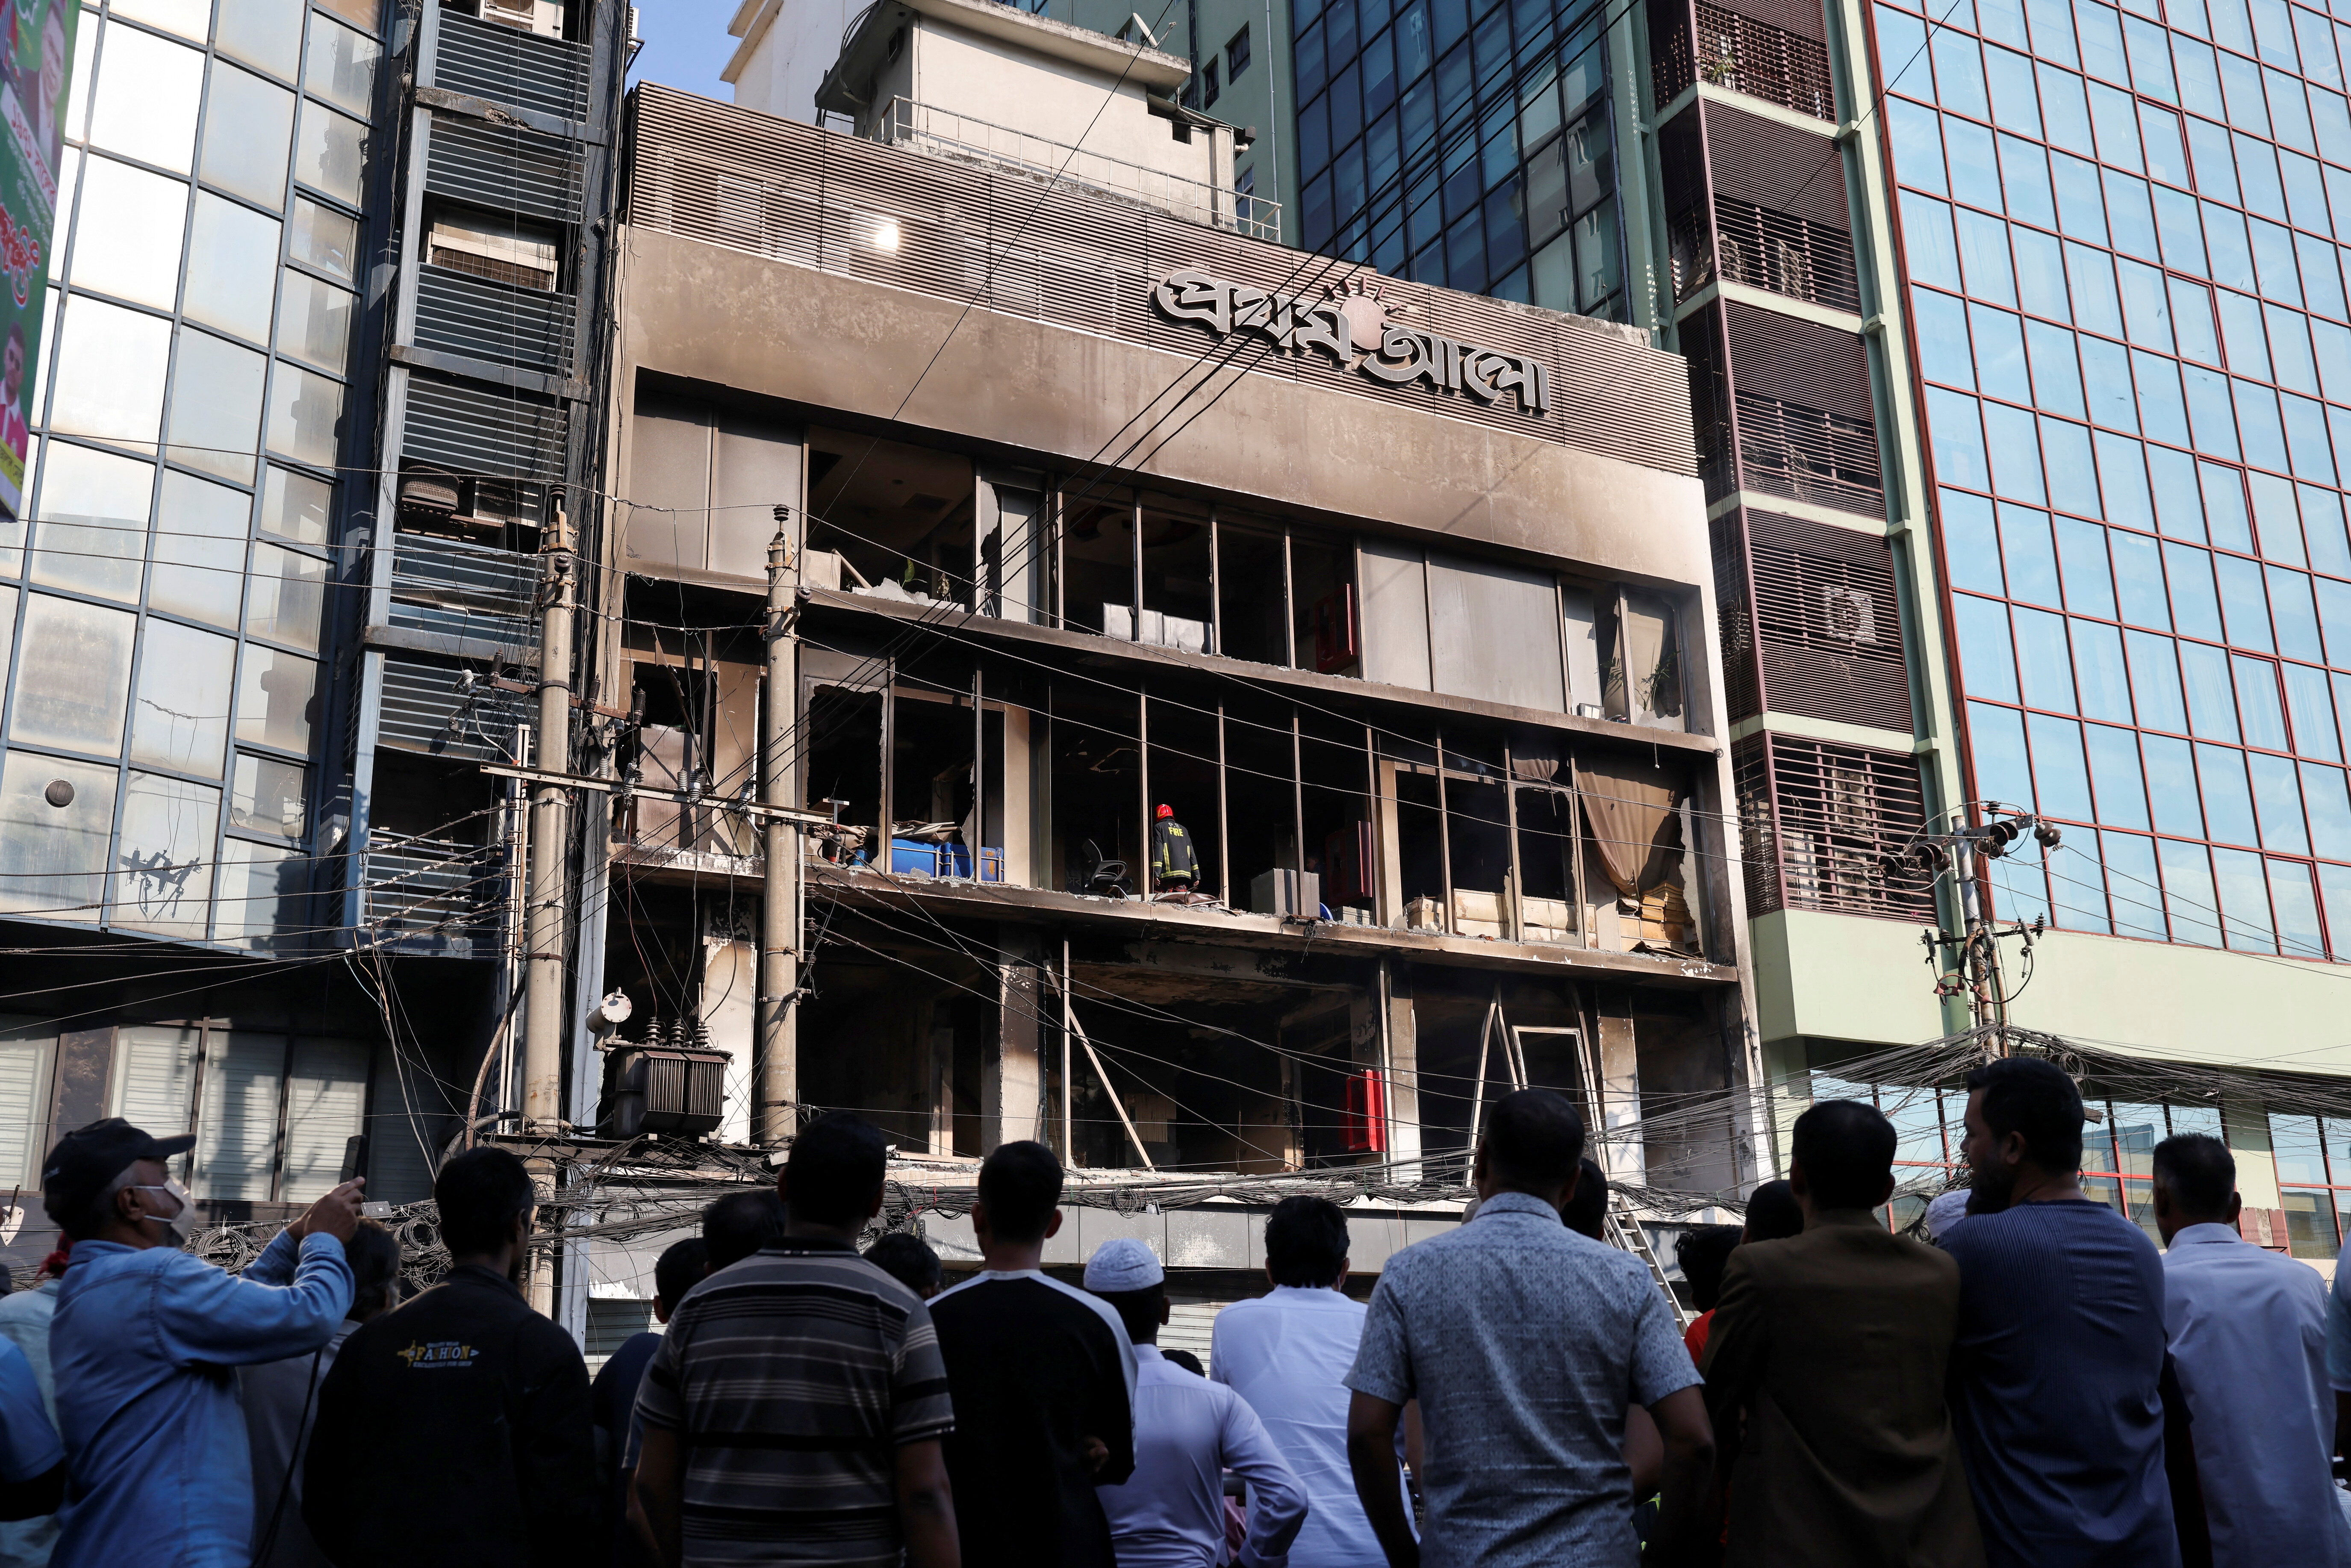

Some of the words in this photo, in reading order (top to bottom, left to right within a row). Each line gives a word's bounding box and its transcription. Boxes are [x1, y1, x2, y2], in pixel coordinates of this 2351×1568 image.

[1154, 269, 1353, 364] প্রথম
[1362, 321, 1552, 413] আলো
[1168, 827, 1184, 837] FIRE
[415, 1346, 471, 1360] FASHION
